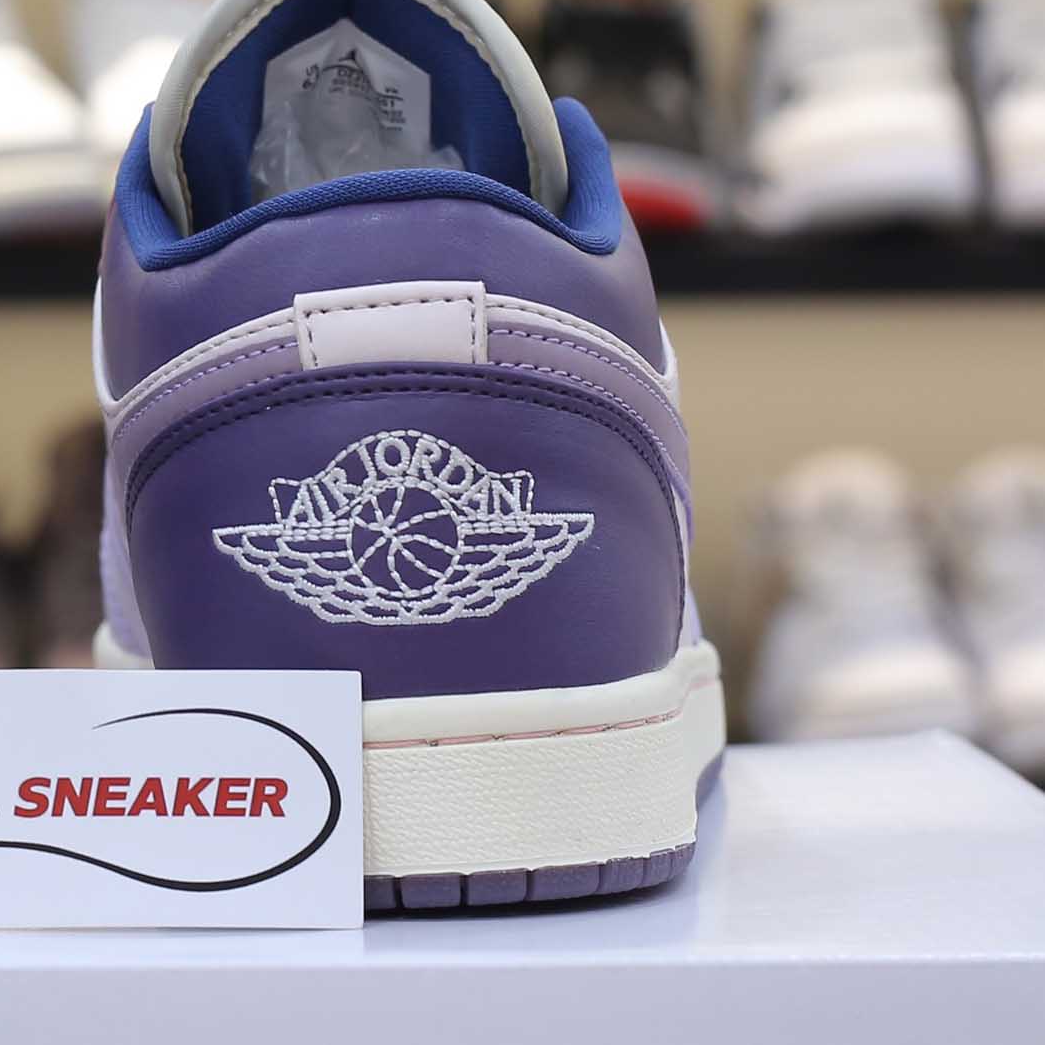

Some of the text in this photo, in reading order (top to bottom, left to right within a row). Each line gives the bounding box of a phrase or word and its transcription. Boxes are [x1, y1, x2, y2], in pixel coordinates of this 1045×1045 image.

[286, 436, 525, 526] AIR JORDAN
[12, 776, 289, 818] SNEAKER
